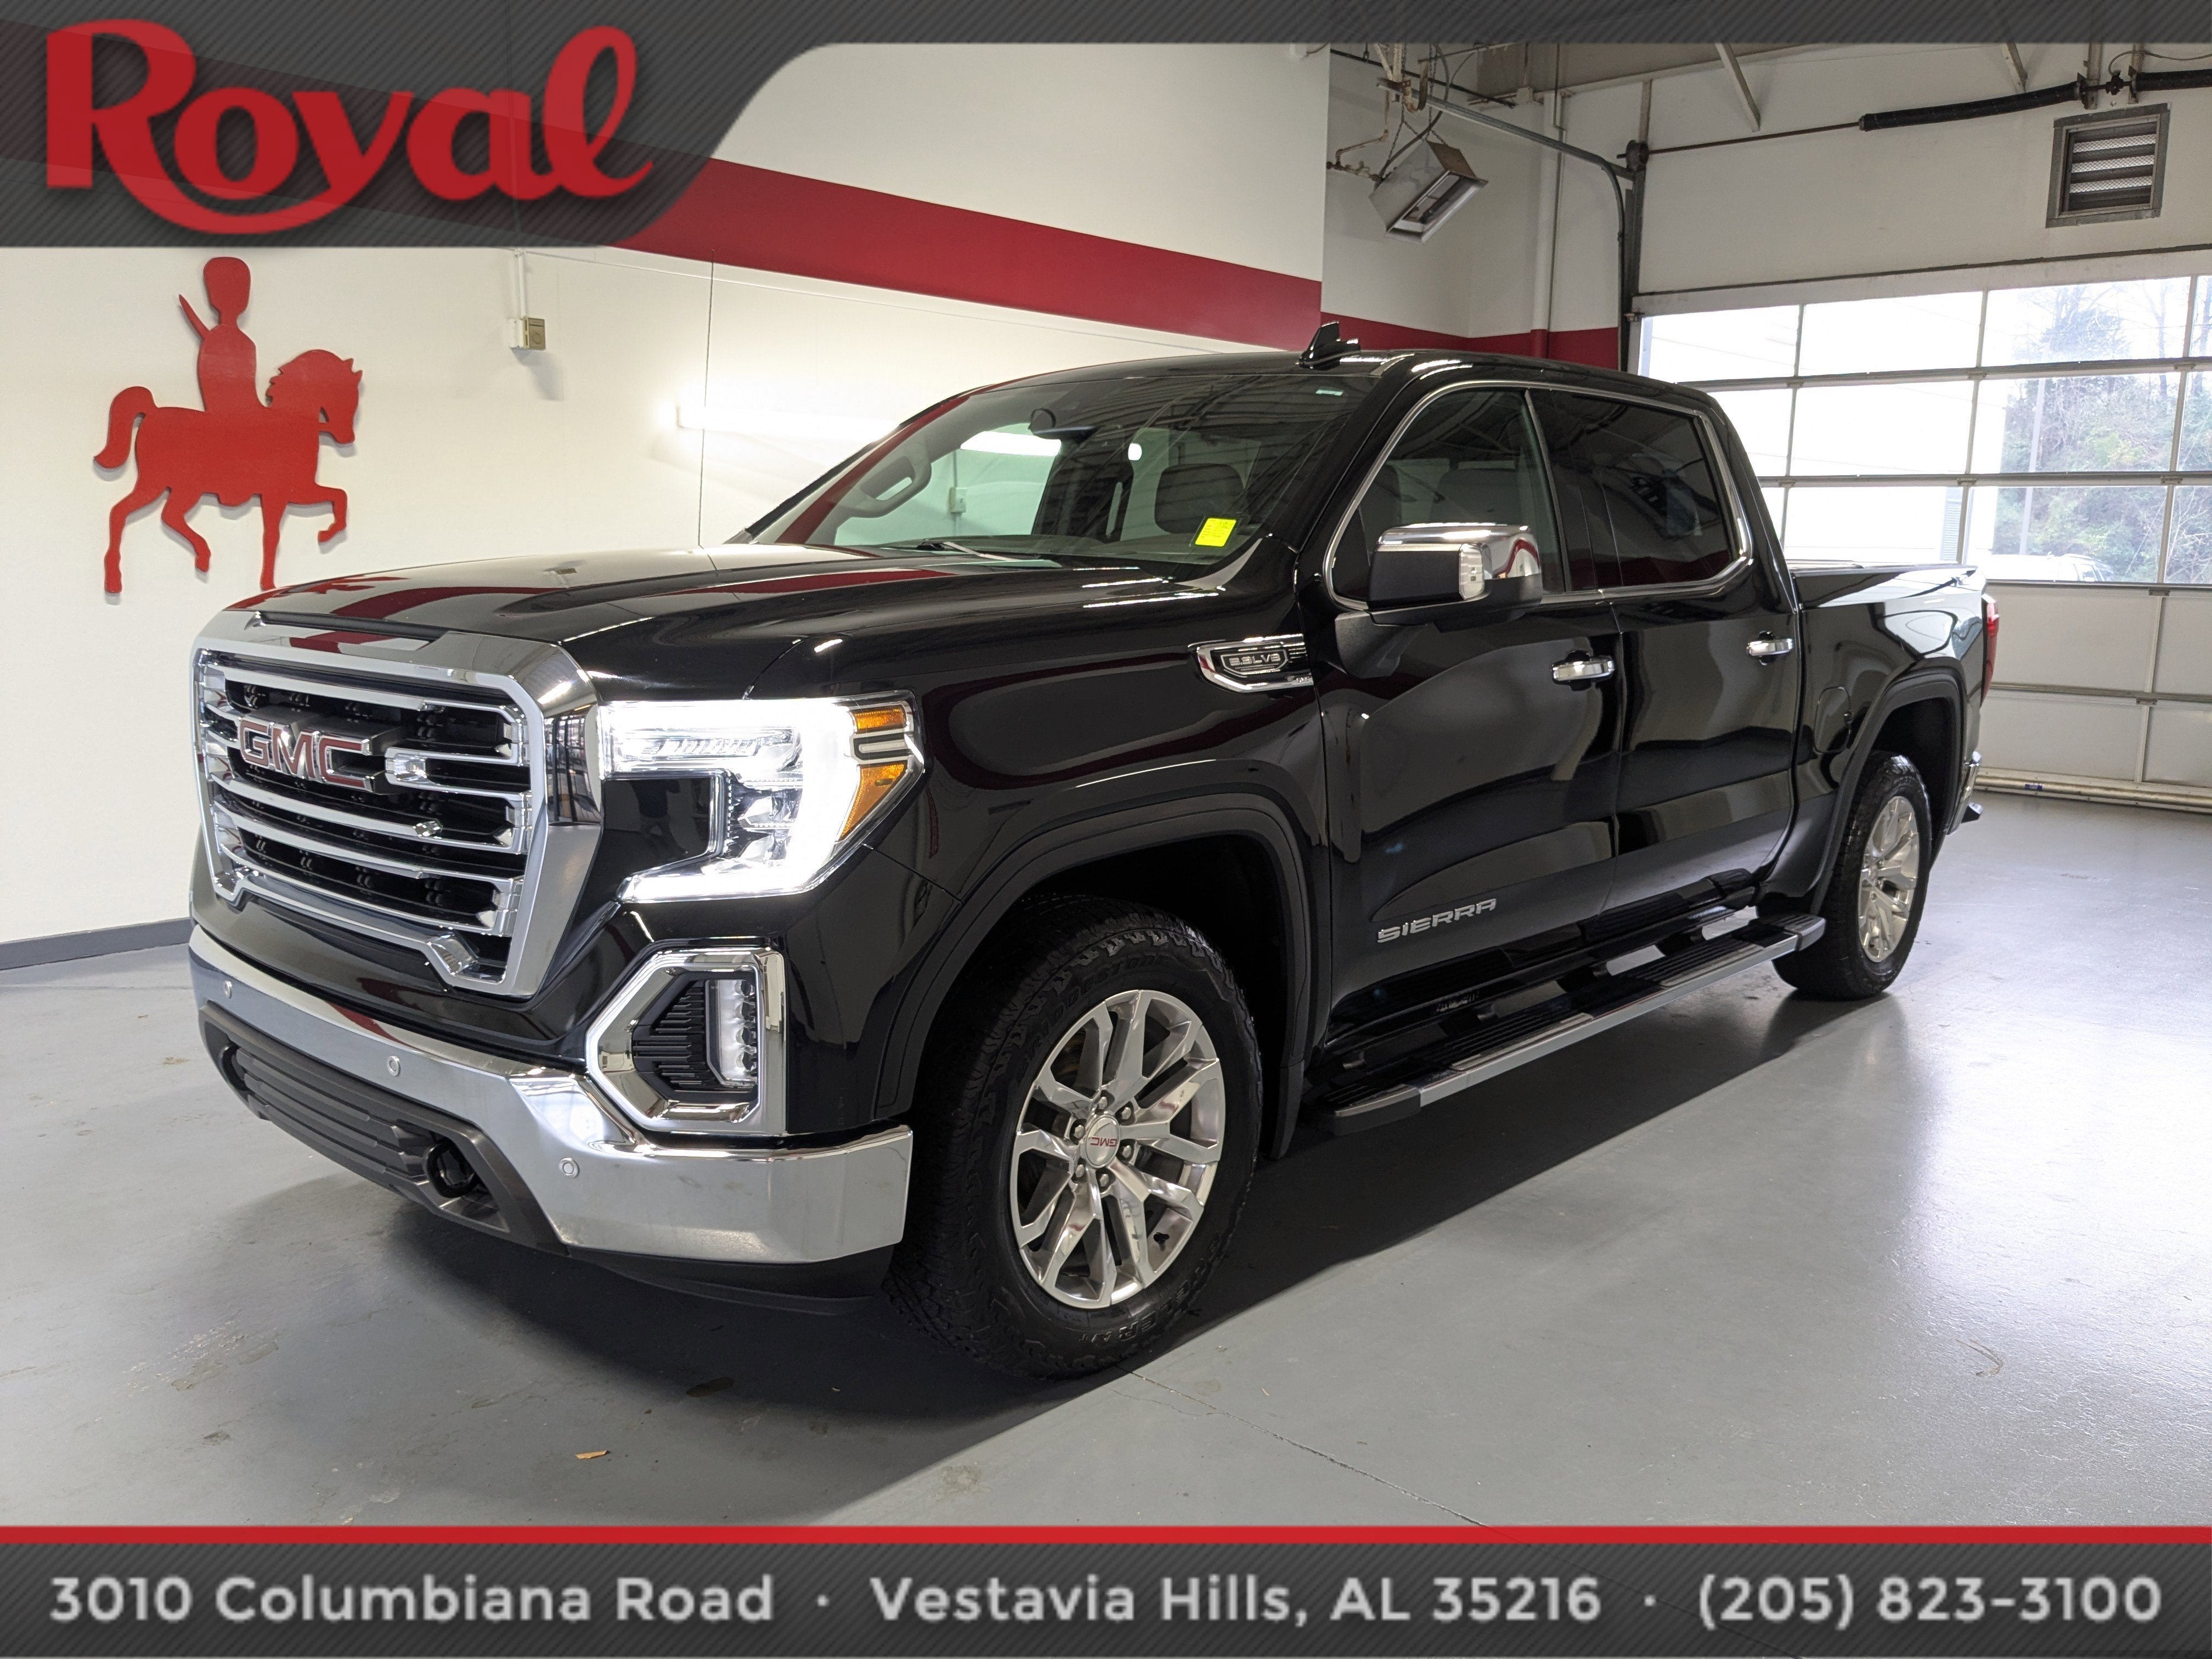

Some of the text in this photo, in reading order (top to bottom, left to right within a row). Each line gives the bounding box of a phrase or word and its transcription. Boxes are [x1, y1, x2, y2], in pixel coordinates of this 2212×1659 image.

[238, 716, 374, 792] GMC
[1377, 898, 1497, 943] SIERRA
[1090, 1137, 1118, 1147] GMC
